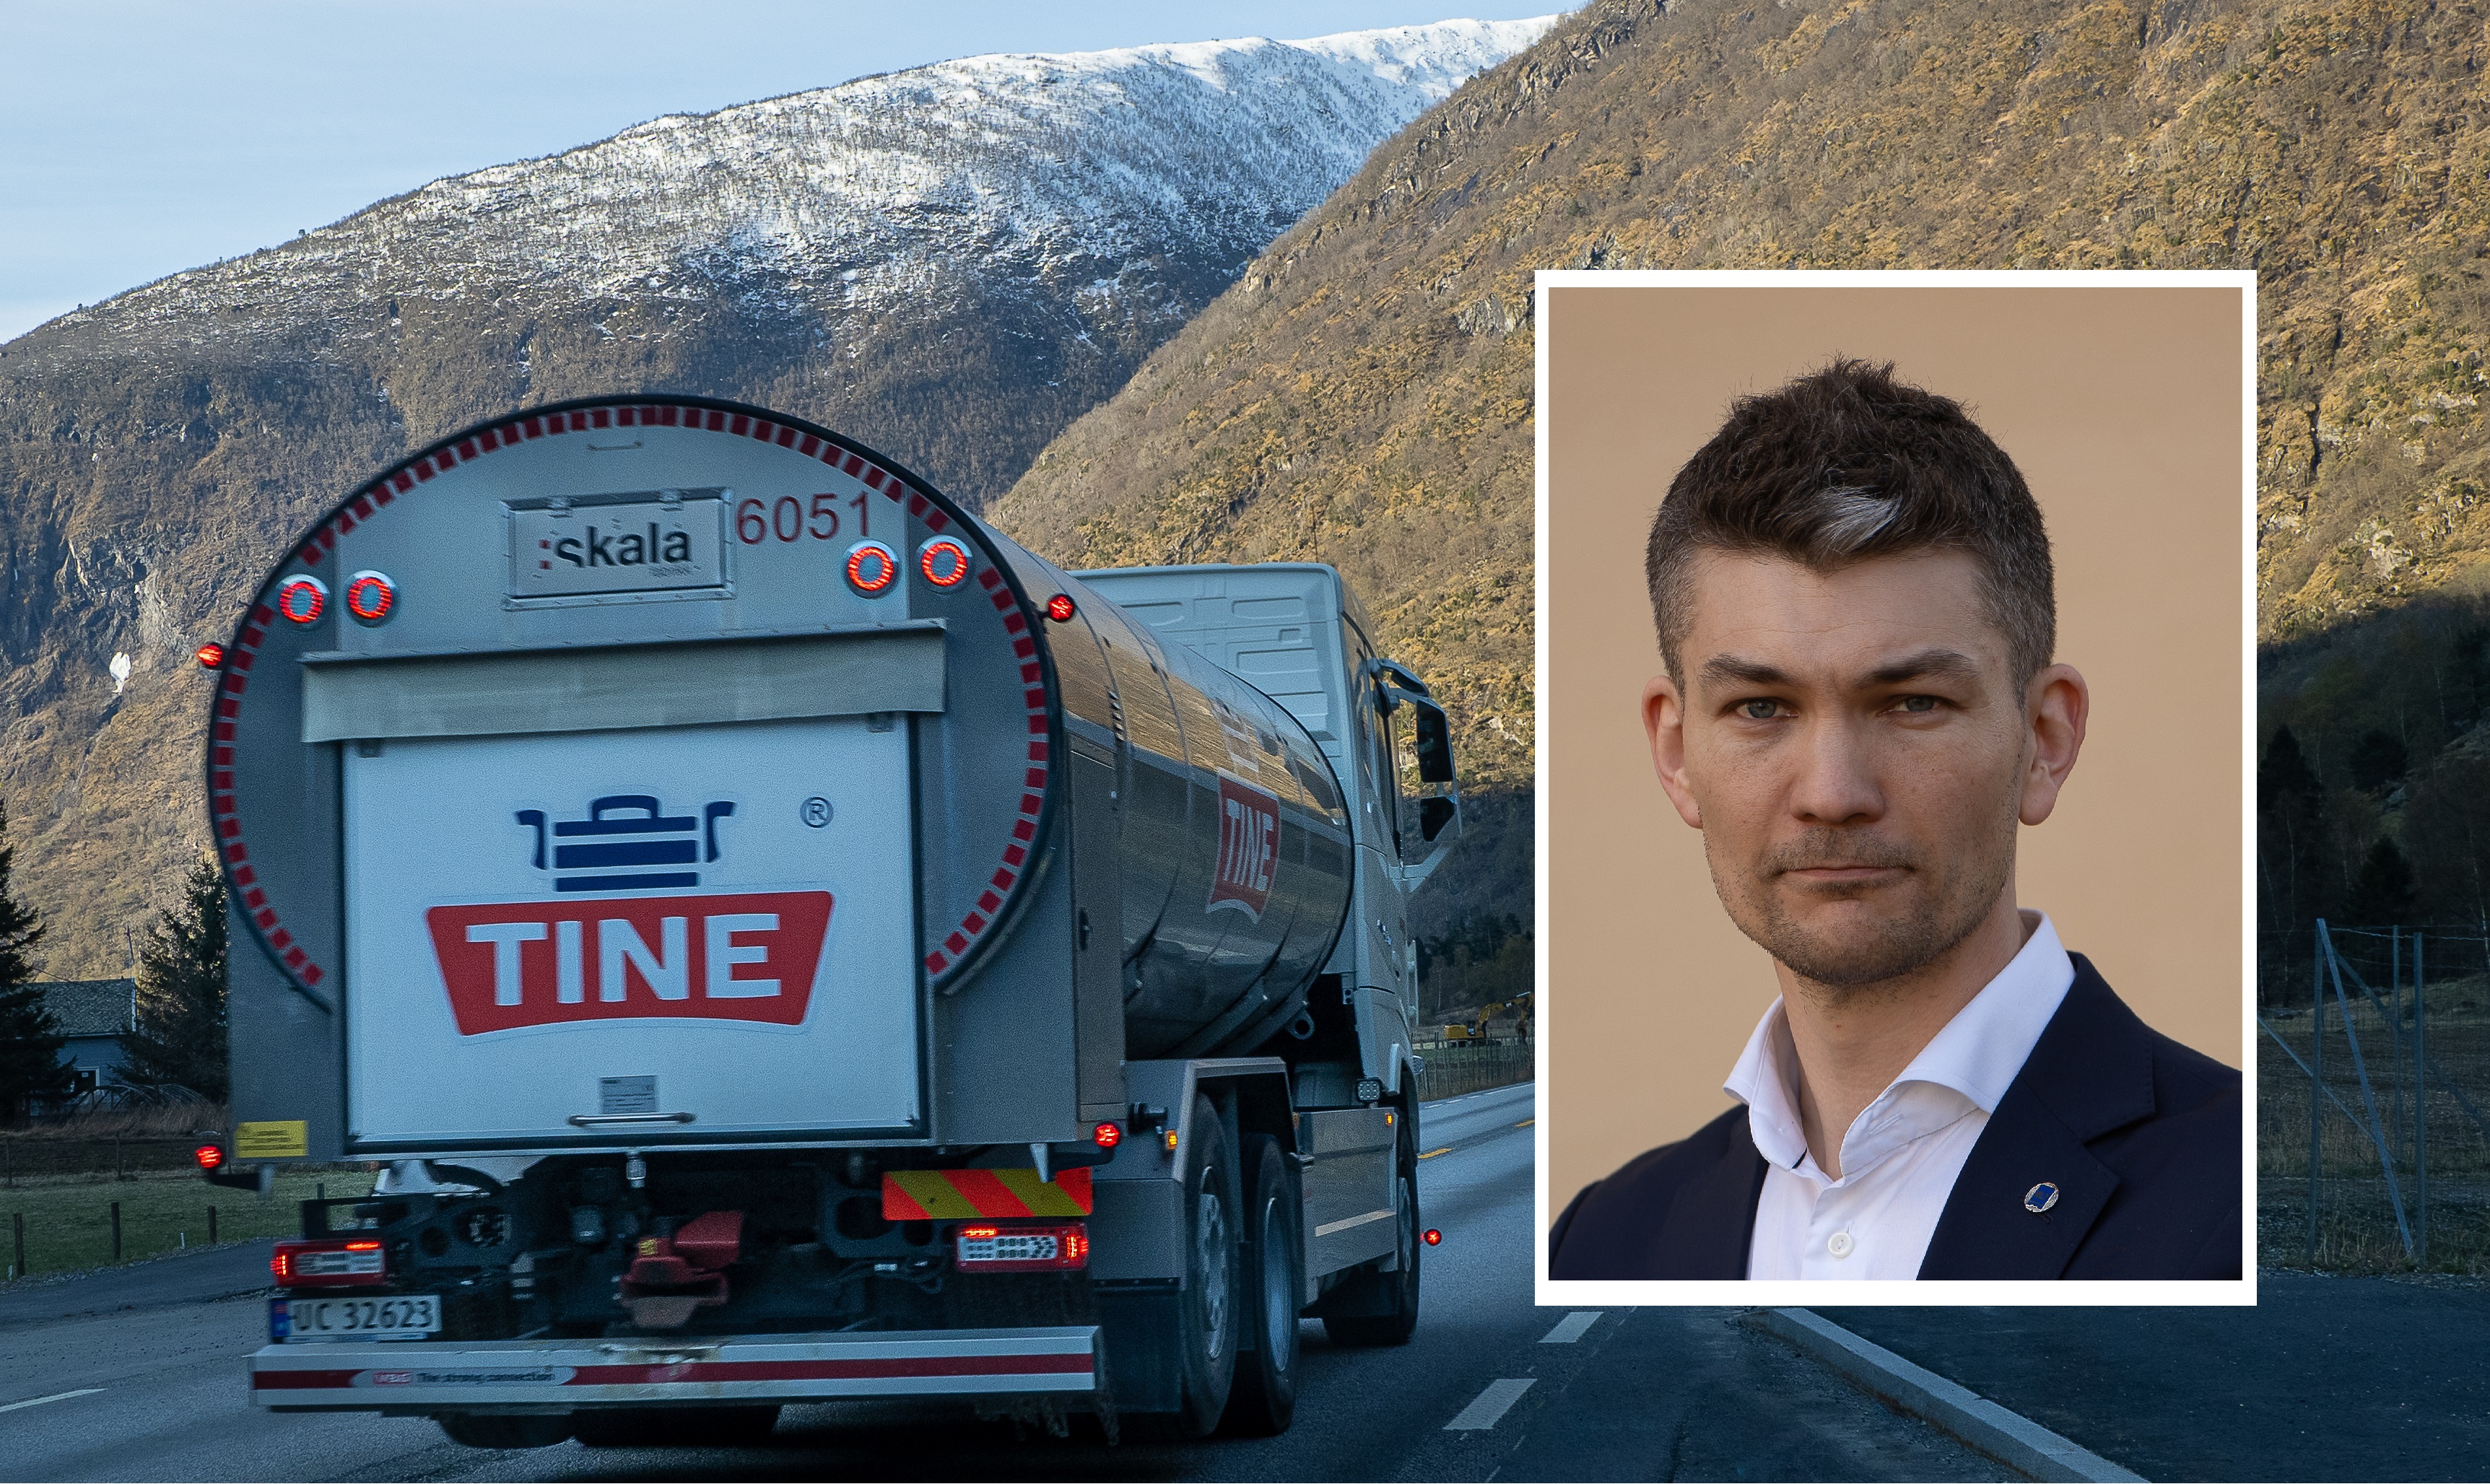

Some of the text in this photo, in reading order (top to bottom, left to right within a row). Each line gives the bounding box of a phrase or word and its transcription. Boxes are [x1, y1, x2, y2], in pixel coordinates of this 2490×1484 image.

[736, 491, 869, 545] 6051
[1223, 798, 1274, 892] TINE
[466, 913, 782, 1006] TINE
[293, 1303, 333, 1331] UC
[342, 1300, 432, 1330] 32623
